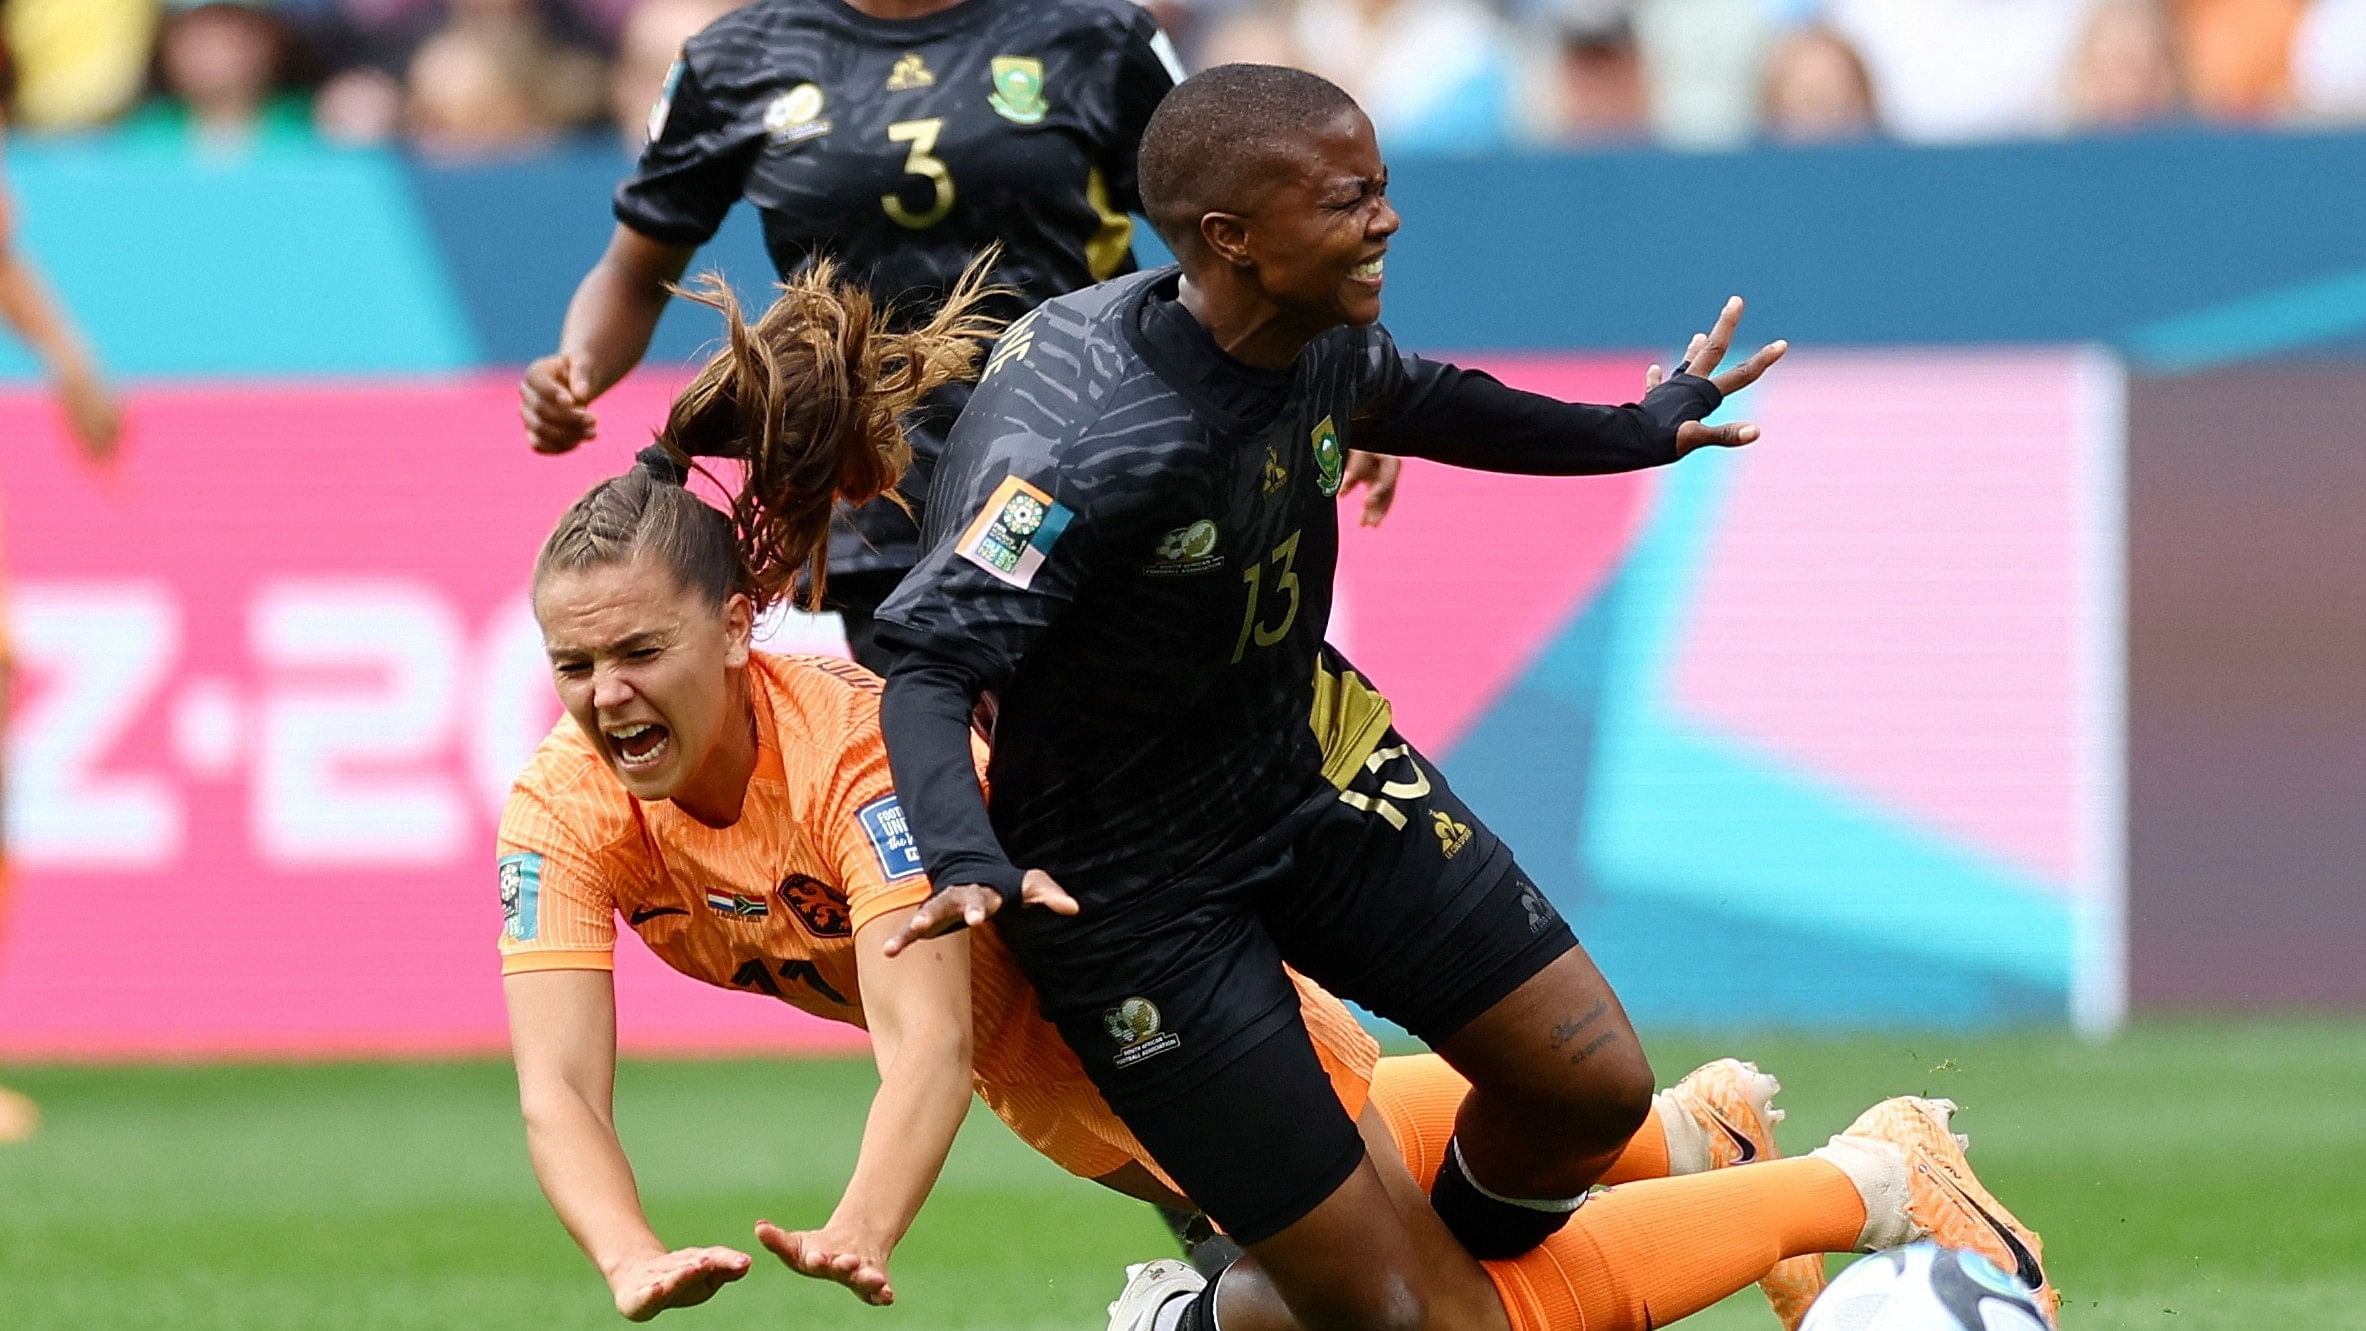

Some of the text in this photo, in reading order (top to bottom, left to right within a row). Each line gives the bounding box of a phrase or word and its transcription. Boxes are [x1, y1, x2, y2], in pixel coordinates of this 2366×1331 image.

[881, 117, 956, 230] 3
[1231, 529, 1301, 664] 13
[876, 806, 904, 823] FOOT
[882, 817, 909, 836] UNI
[730, 957, 850, 1006] 11
